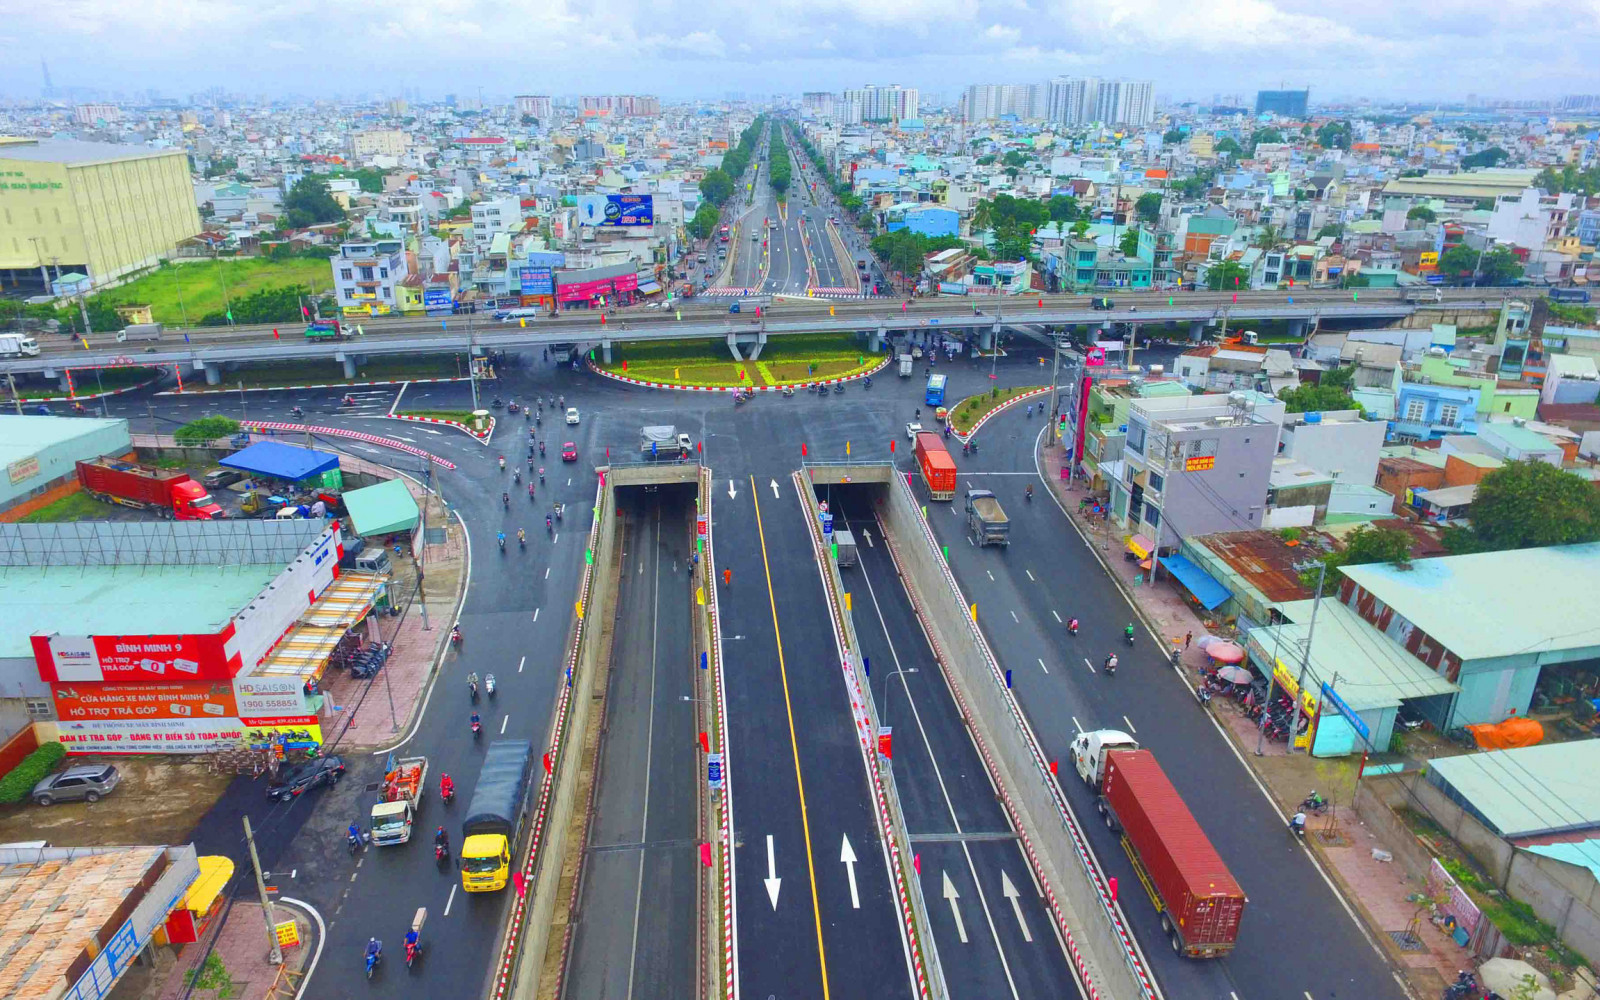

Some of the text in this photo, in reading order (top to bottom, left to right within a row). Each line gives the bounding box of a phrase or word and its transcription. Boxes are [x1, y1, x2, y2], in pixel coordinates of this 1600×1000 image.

[115, 642, 183, 653] BÌNH MINH 9
[100, 694, 124, 702] HÀNG
[138, 694, 156, 702] MÁY
[158, 693, 179, 701] BÌNH
[266, 699, 298, 708] 558854
[88, 708, 110, 717] TRỢ
[136, 706, 158, 715] GÓP
